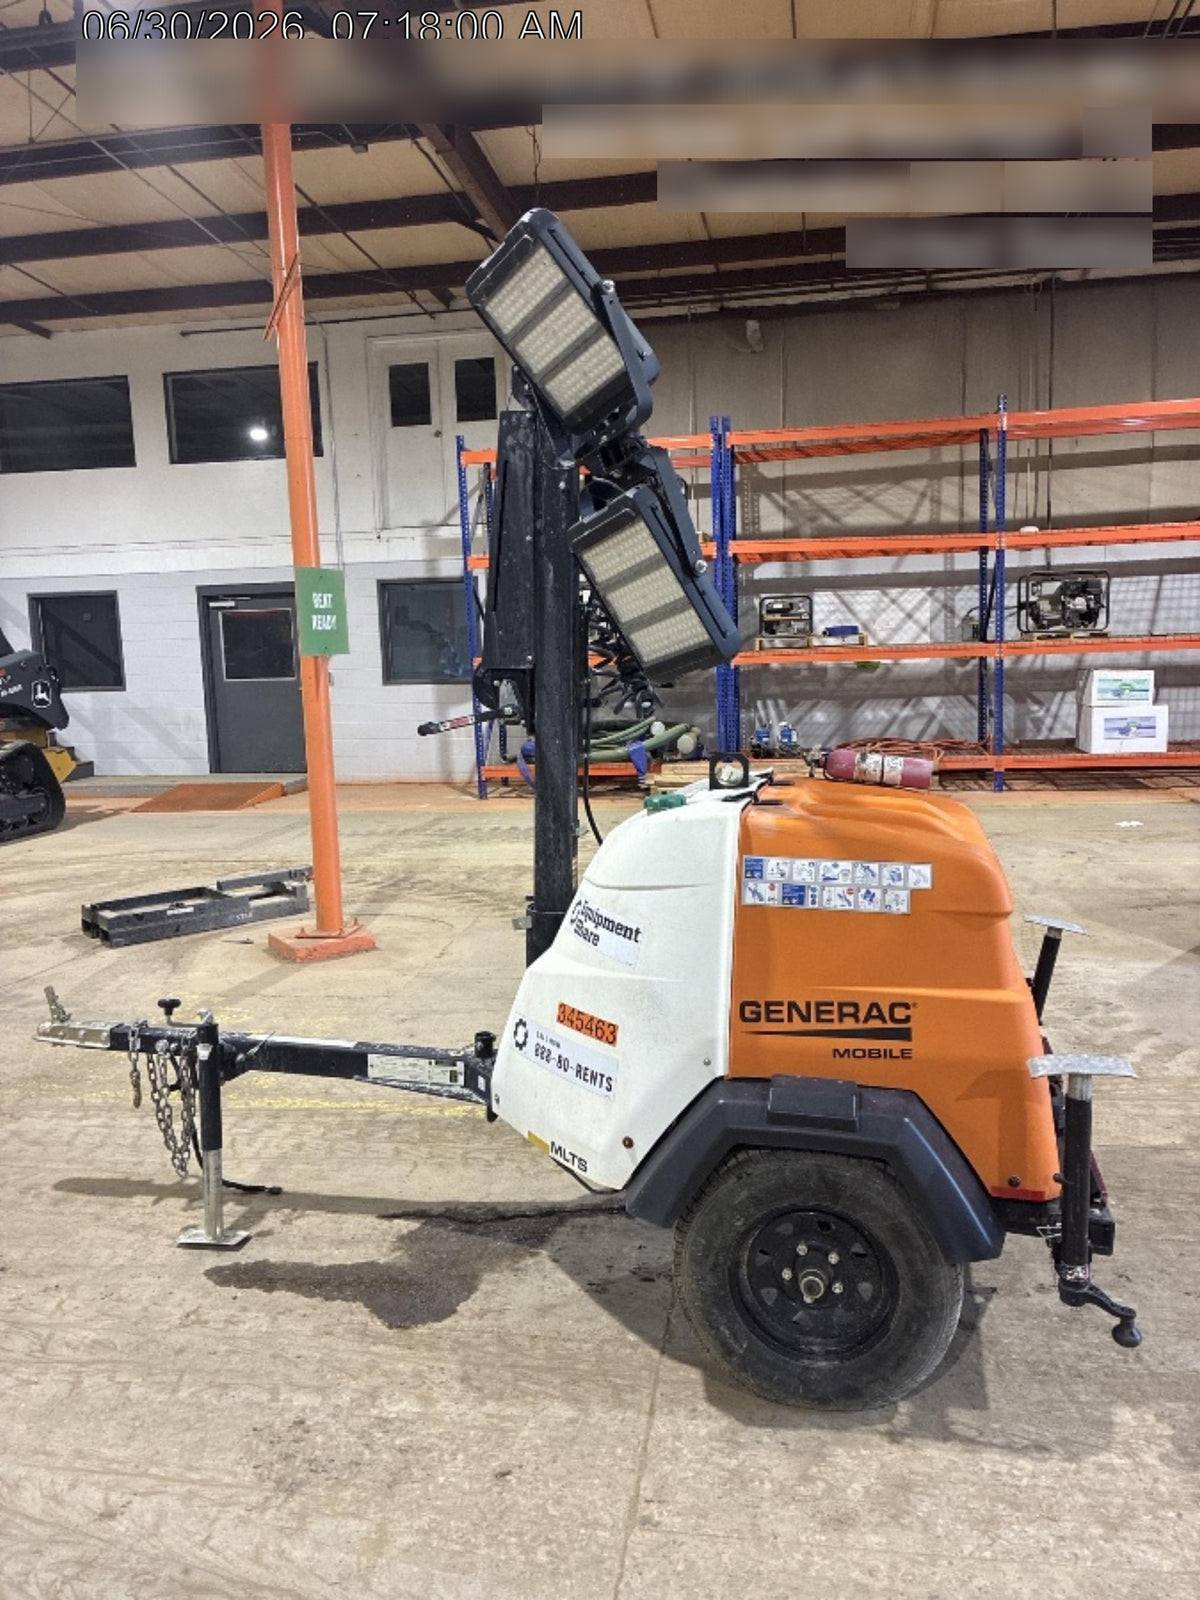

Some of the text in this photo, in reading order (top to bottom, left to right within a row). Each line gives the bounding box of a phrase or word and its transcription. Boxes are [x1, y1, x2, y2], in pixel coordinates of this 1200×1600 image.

[558, 1004, 617, 1045] 345463
[739, 1000, 912, 1024] GENERAC
[832, 1048, 913, 1059] MOBILE
[550, 1140, 588, 1173] MLTS
